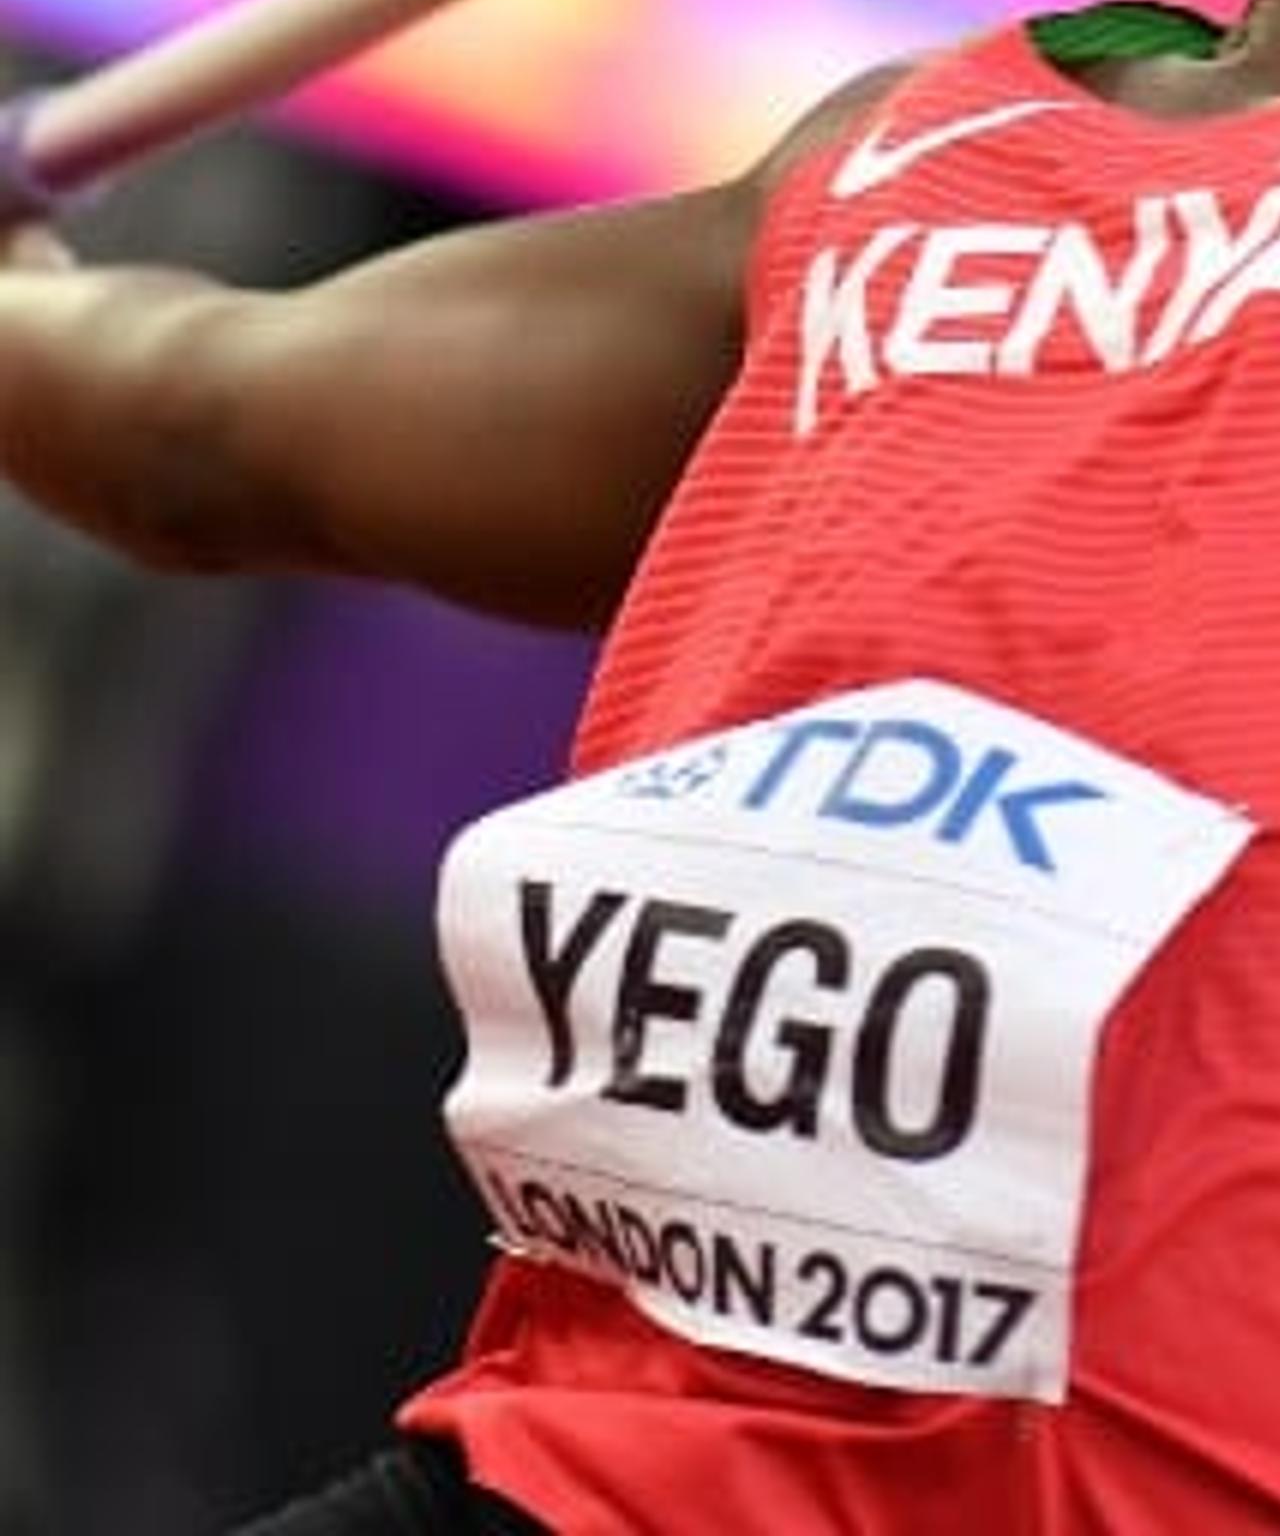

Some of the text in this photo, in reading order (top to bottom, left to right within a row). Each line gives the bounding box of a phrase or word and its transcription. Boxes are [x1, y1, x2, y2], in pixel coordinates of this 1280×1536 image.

[742, 719, 1106, 873] TDK
[518, 879, 992, 1163] YEGO
[491, 1173, 1039, 1364] LONDON 2017
